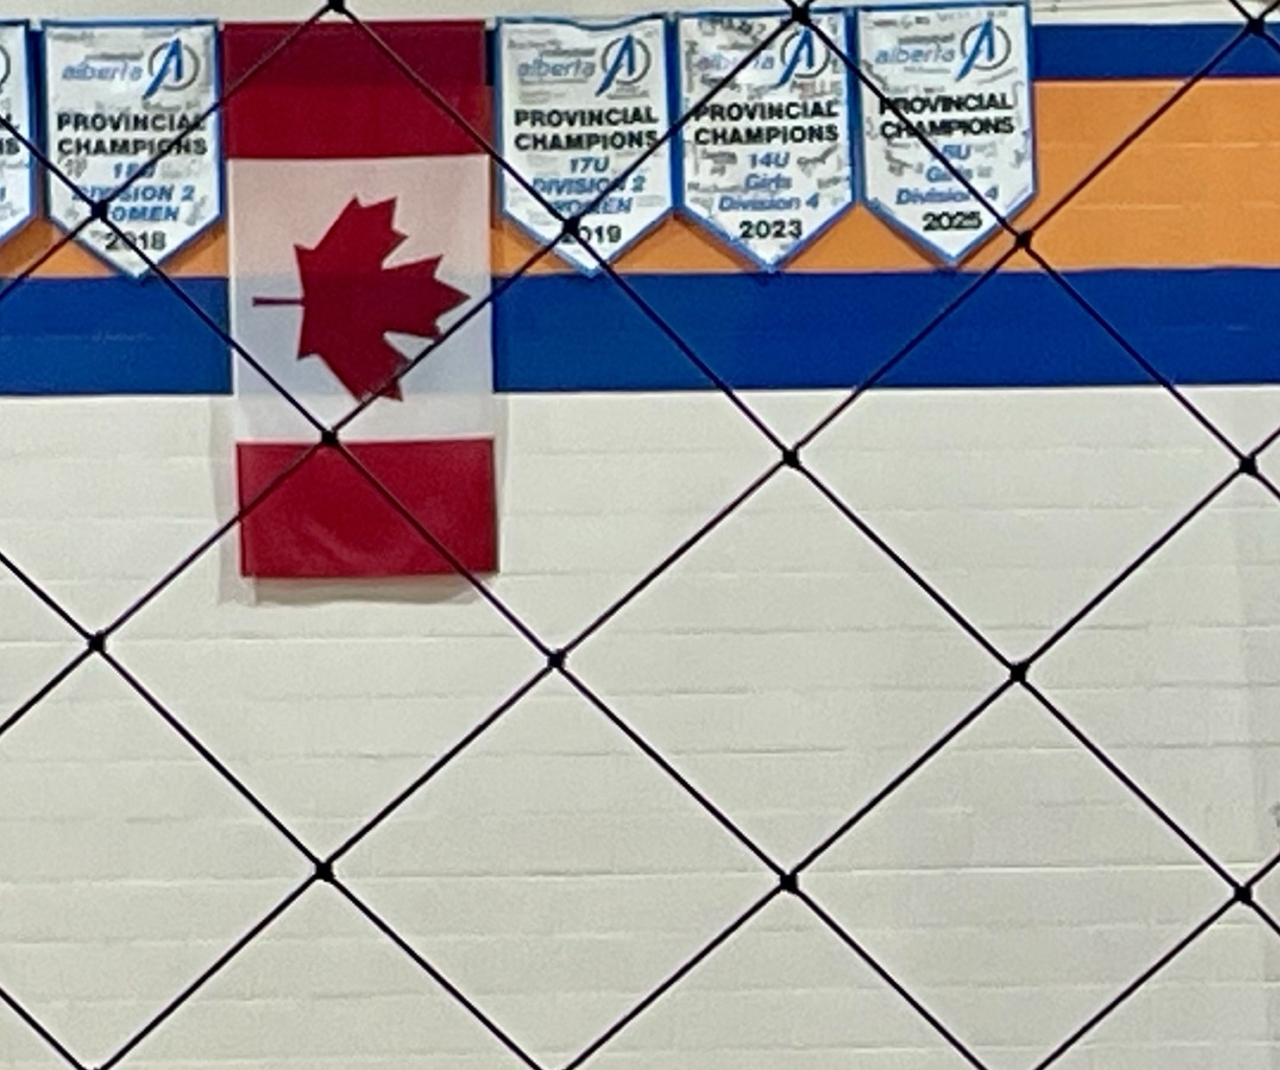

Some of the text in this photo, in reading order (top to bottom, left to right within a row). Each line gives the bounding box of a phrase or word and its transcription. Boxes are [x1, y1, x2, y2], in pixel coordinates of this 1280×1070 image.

[875, 45, 955, 64] alberta
[518, 58, 597, 78] alberta
[696, 102, 839, 122] PROVINCIAL
[879, 92, 1013, 115] PROVINCIAL
[57, 112, 206, 132] PROVINCIAL
[514, 106, 659, 128] PROVINCIAL
[694, 124, 839, 146] CHAMPIONS
[881, 116, 1015, 139] CHAMPIONS
[57, 137, 208, 156] CHAMPIONS
[515, 130, 658, 151] CHAMPIONS
[570, 155, 611, 174] 17U
[750, 152, 791, 169] 14U
[98, 204, 179, 221] OMEN
[922, 211, 982, 231] 2025
[739, 219, 803, 239] 2023
